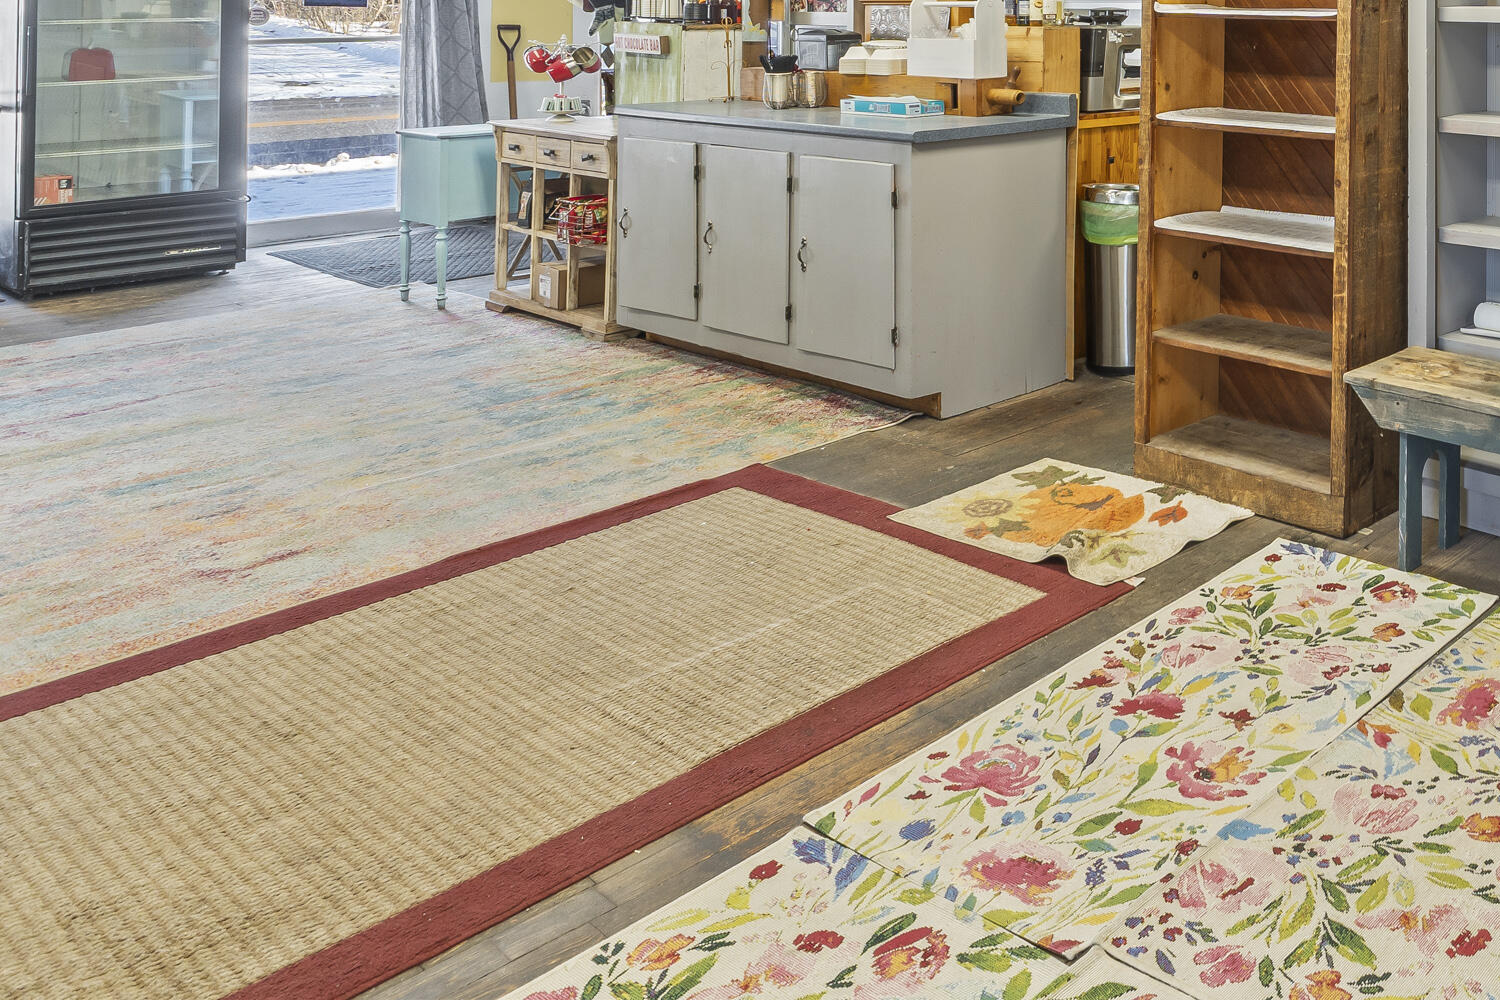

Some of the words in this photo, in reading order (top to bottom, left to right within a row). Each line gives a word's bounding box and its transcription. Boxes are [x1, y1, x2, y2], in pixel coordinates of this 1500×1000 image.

[615, 36, 623, 49] HOT
[624, 37, 649, 51] CHOCOLATE
[650, 38, 660, 52] BAR
